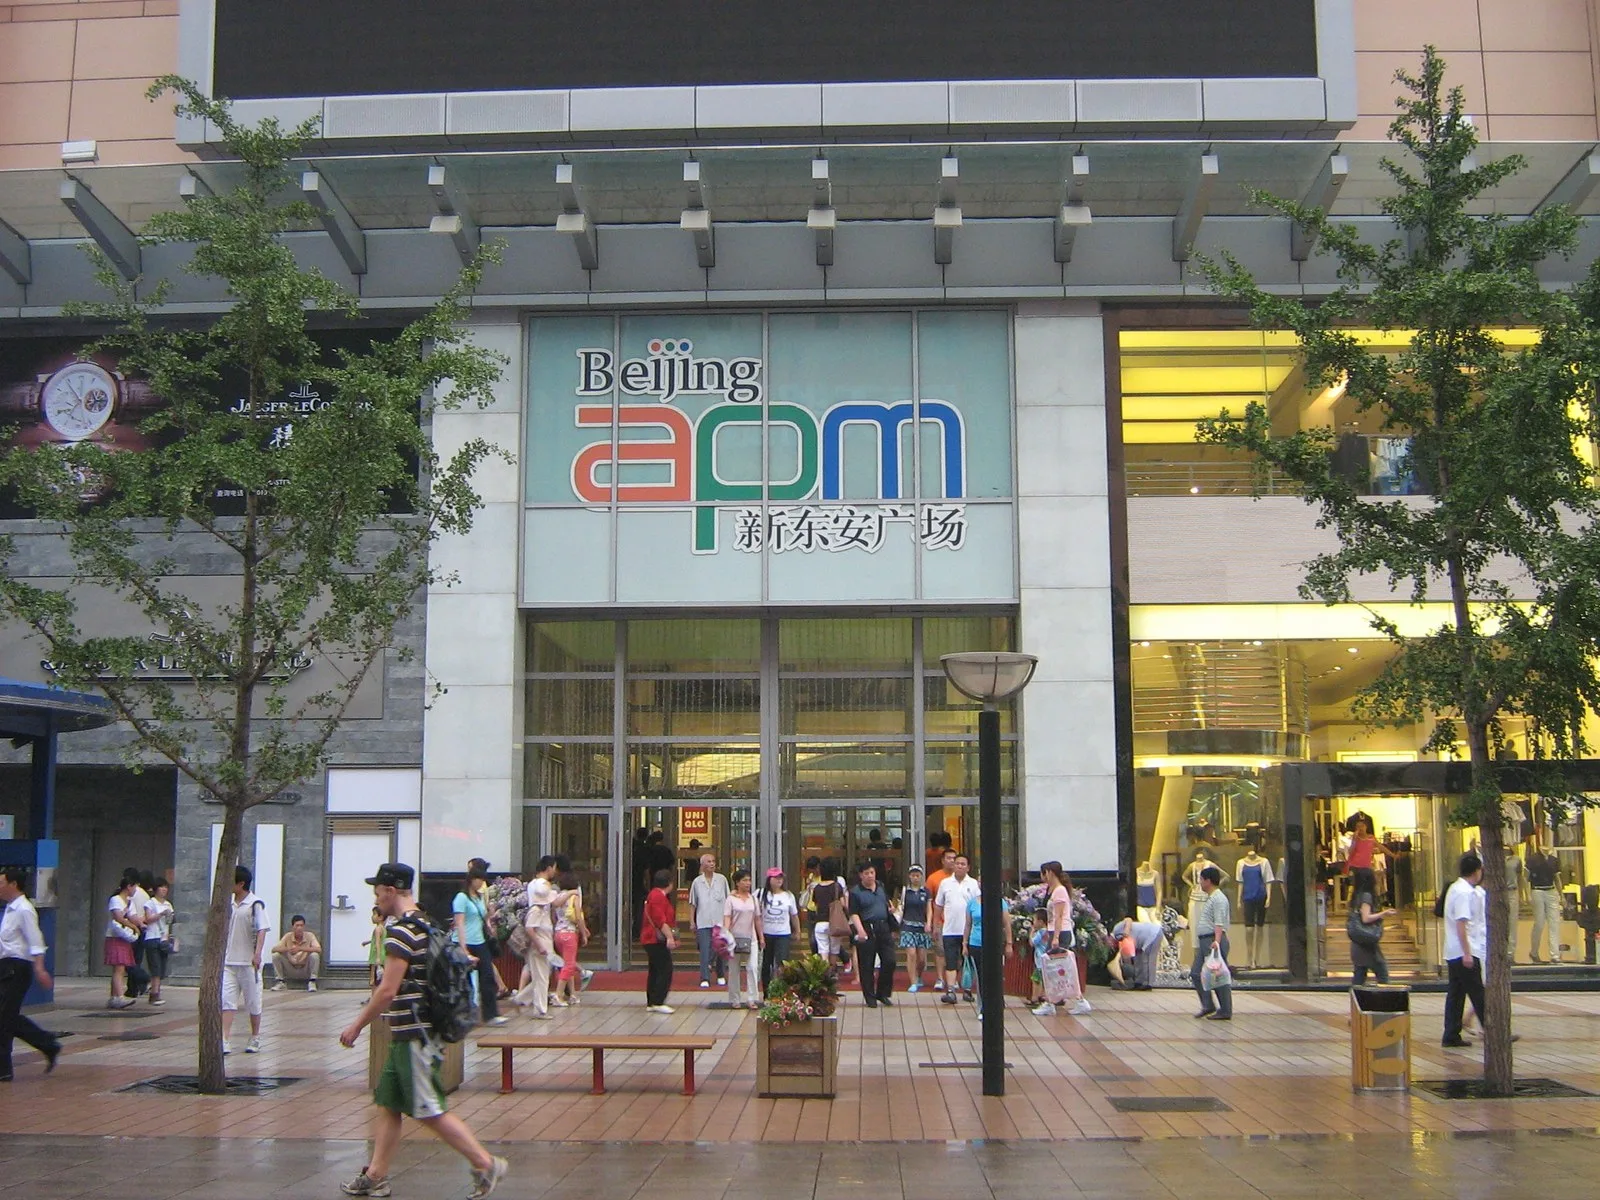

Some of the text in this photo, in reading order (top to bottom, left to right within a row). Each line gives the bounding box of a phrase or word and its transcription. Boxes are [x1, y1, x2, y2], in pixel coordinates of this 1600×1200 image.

[580, 340, 760, 402] Beijing
[573, 403, 965, 553] apm
[737, 507, 964, 552] 新东安广场
[684, 820, 705, 828] QLO
[685, 811, 704, 819] UNI
